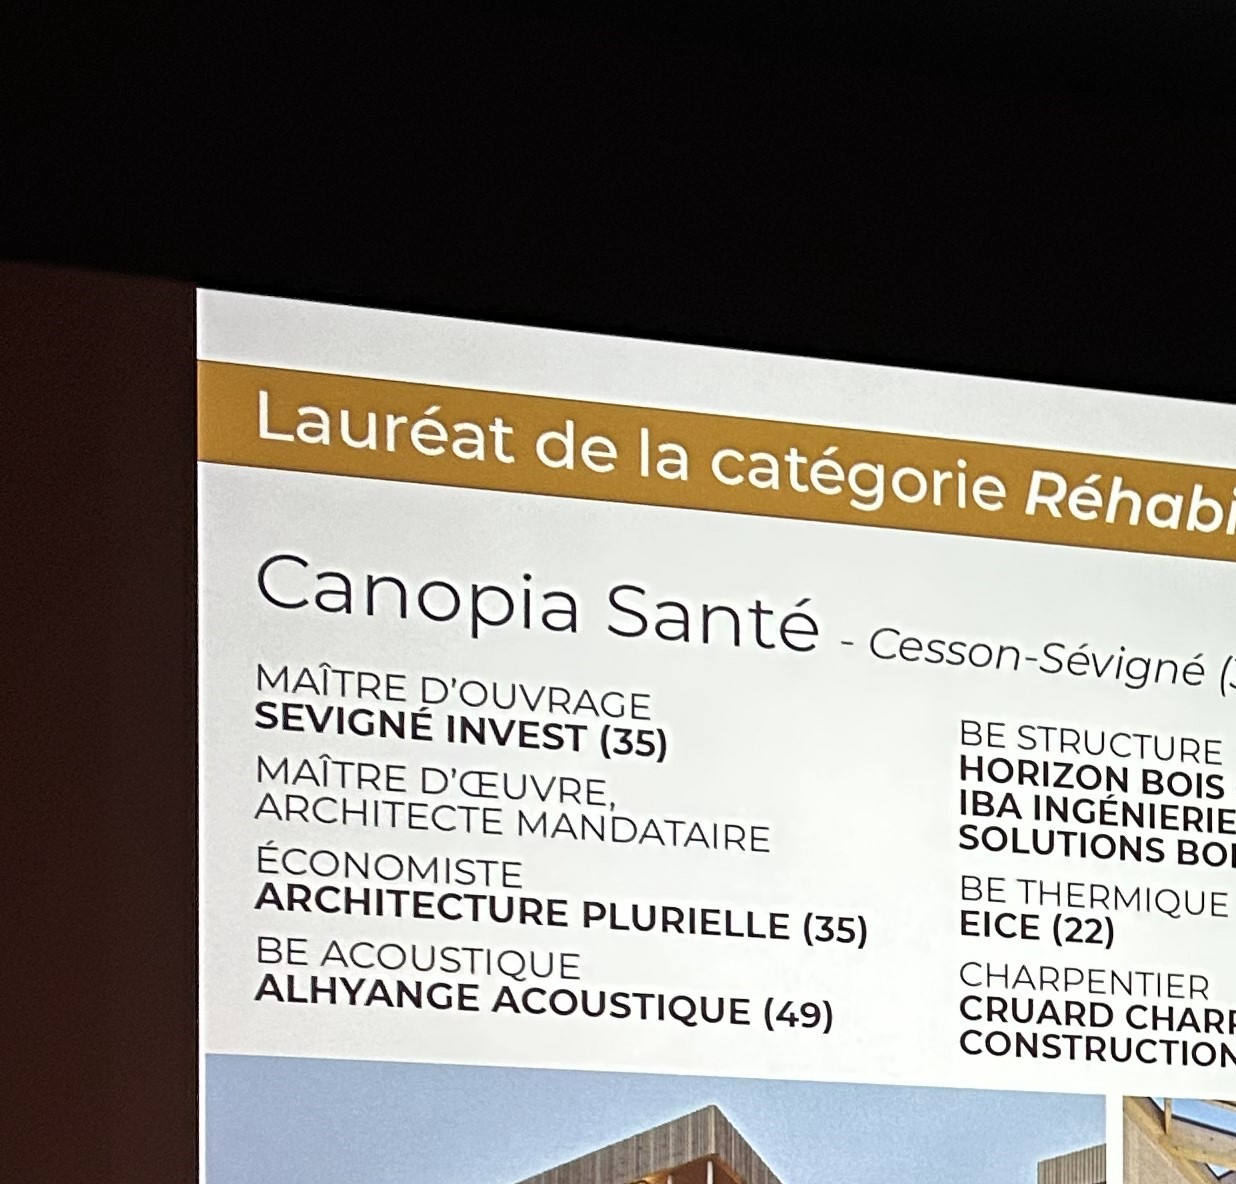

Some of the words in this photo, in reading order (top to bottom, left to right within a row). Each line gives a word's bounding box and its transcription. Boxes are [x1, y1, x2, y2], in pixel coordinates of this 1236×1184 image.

[258, 390, 515, 464] Lauréat
[535, 419, 618, 473] de
[640, 427, 689, 482] la
[711, 446, 1007, 512] catégorie
[257, 554, 578, 640] Canopia
[607, 583, 819, 653] Santé
[869, 627, 1205, 690] Cesson-Sévigné
[257, 661, 407, 703] MAÎTRE
[254, 700, 434, 742] SEVIGNÉ
[446, 714, 589, 753] INVEST
[599, 723, 667, 764] (35)
[960, 718, 1007, 749] BE
[1017, 724, 1223, 766] STRUCTURE
[257, 753, 407, 793] MAÎTRE
[959, 753, 1129, 794] HORIZON
[1141, 768, 1225, 801] BOIS
[253, 792, 504, 836] ARCHITECTE
[517, 809, 772, 854] MANDATAIRE
[959, 788, 1024, 821] IBA
[257, 839, 523, 890] ÉCONOMISTE
[958, 823, 1166, 864] SOLUTIONS
[253, 881, 569, 928] ARCHITECTURE
[582, 900, 791, 941] PLURIELLE
[803, 911, 868, 950] (35)
[961, 874, 1007, 904] BE
[1015, 878, 1229, 920] THERMIQUE
[960, 909, 1041, 941] EICE
[1052, 912, 1115, 951] (22)
[257, 935, 309, 966] BE
[319, 939, 581, 983] ACOUSTIQUE
[959, 961, 1209, 1001] CHARPENTIER
[253, 972, 481, 1012] ALHYANGE
[490, 985, 751, 1028] ACOUSTIQUE
[763, 996, 834, 1035] (49)
[959, 994, 1114, 1029] CRUARD
